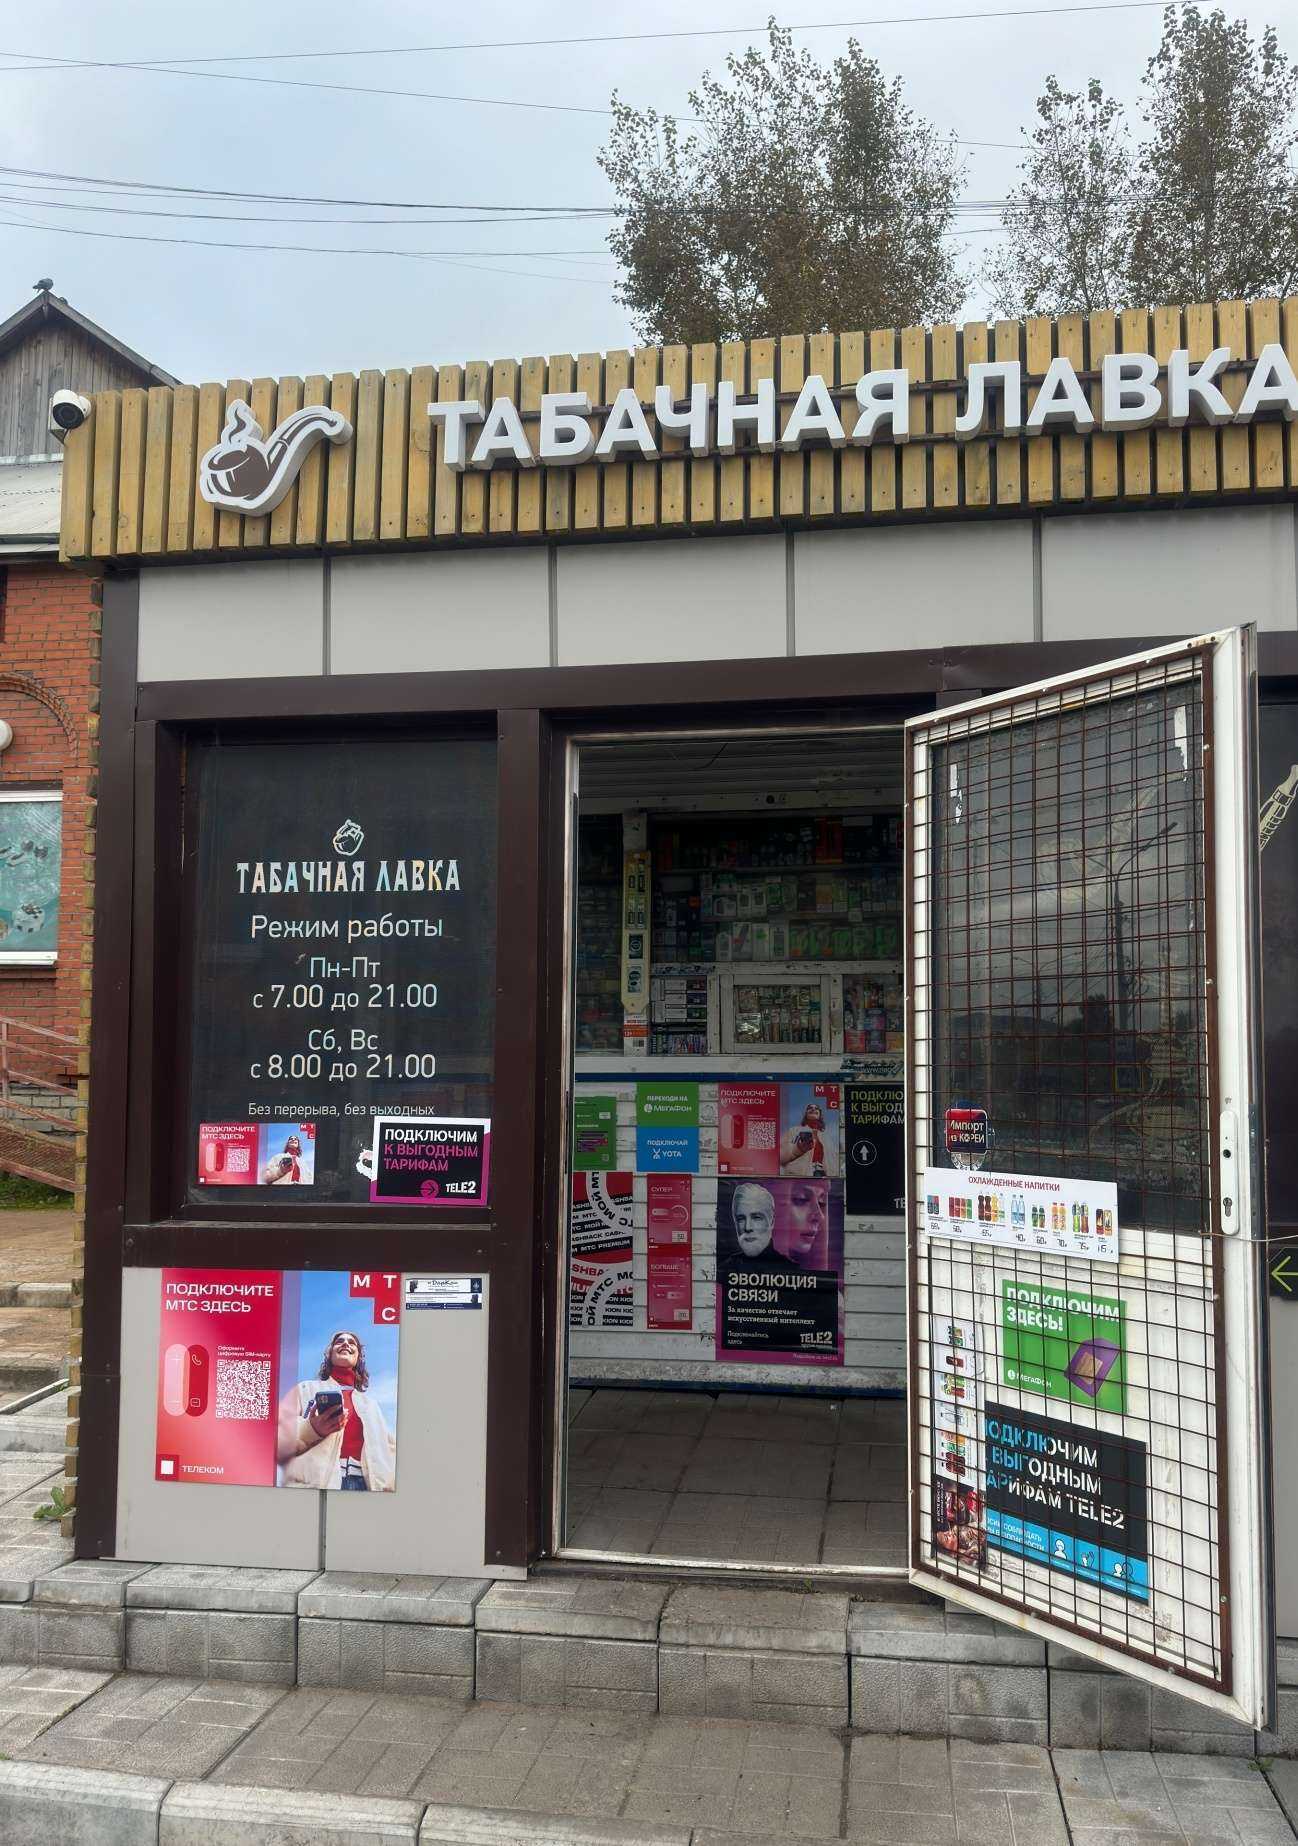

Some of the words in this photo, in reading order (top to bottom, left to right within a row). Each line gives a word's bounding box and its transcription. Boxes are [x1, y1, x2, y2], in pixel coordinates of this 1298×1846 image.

[428, 368, 909, 471] ТАБАЧНАЯ
[956, 344, 1298, 440] ЛАВКА
[236, 860, 366, 894] ТАБАЧНАЯ
[375, 859, 462, 892] ЛАВКА
[251, 914, 339, 938] Режим
[347, 914, 443, 944] работы
[309, 956, 381, 979] Пн-Пт
[252, 990, 263, 1008] с
[270, 984, 324, 1008] 7.00
[331, 991, 359, 1011] до
[367, 984, 437, 1008] 21.00
[308, 1029, 342, 1054] Сб,
[350, 1030, 379, 1051] Вс
[250, 1061, 261, 1079] с
[268, 1055, 322, 1079] 8.00
[329, 1061, 357, 1082] до
[366, 1055, 436, 1079] 21.00
[720, 1089, 776, 1097] ПОДКЛЮЧИТЕ
[248, 1103, 271, 1116] Без
[274, 1104, 341, 1117] перерыва,
[344, 1103, 367, 1116] без
[370, 1104, 435, 1117] выходных
[851, 1103, 858, 1112] К
[950, 1120, 985, 1133] Импорт
[384, 1128, 478, 1143] ПОДКЛЮЧИМ
[384, 1143, 394, 1155] К
[397, 1144, 478, 1159] ВЫГОДНЫМ
[661, 1150, 682, 1158] YOTA
[384, 1158, 449, 1171] ТАРИФАМ
[445, 1180, 476, 1194] TELE2
[968, 1176, 1023, 1189] ОХЛАЖДЕННЫЕ
[1024, 1182, 1060, 1192] НАПИТКИ
[727, 1272, 817, 1290] ЭВОЛЮЦИЯ
[166, 1283, 274, 1298] ПОДКЛЮЧИТЕ
[727, 1288, 779, 1302] СВЯЗИ
[165, 1300, 198, 1311] МТС
[200, 1300, 252, 1313] ЗДЕСЬ
[727, 1305, 736, 1313] За
[736, 1306, 767, 1315] качество
[767, 1308, 798, 1316] отвечает
[1007, 1287, 1121, 1323] ПОДКЛЮЧИМ
[1006, 1306, 1064, 1331] ЗДЕСЬ!
[799, 1331, 833, 1345] TELE2
[182, 1465, 224, 1474] ТЕЛЕКОМ
[986, 1470, 1062, 1509] АРИФАМ
[1066, 1493, 1125, 1530] TELE2
